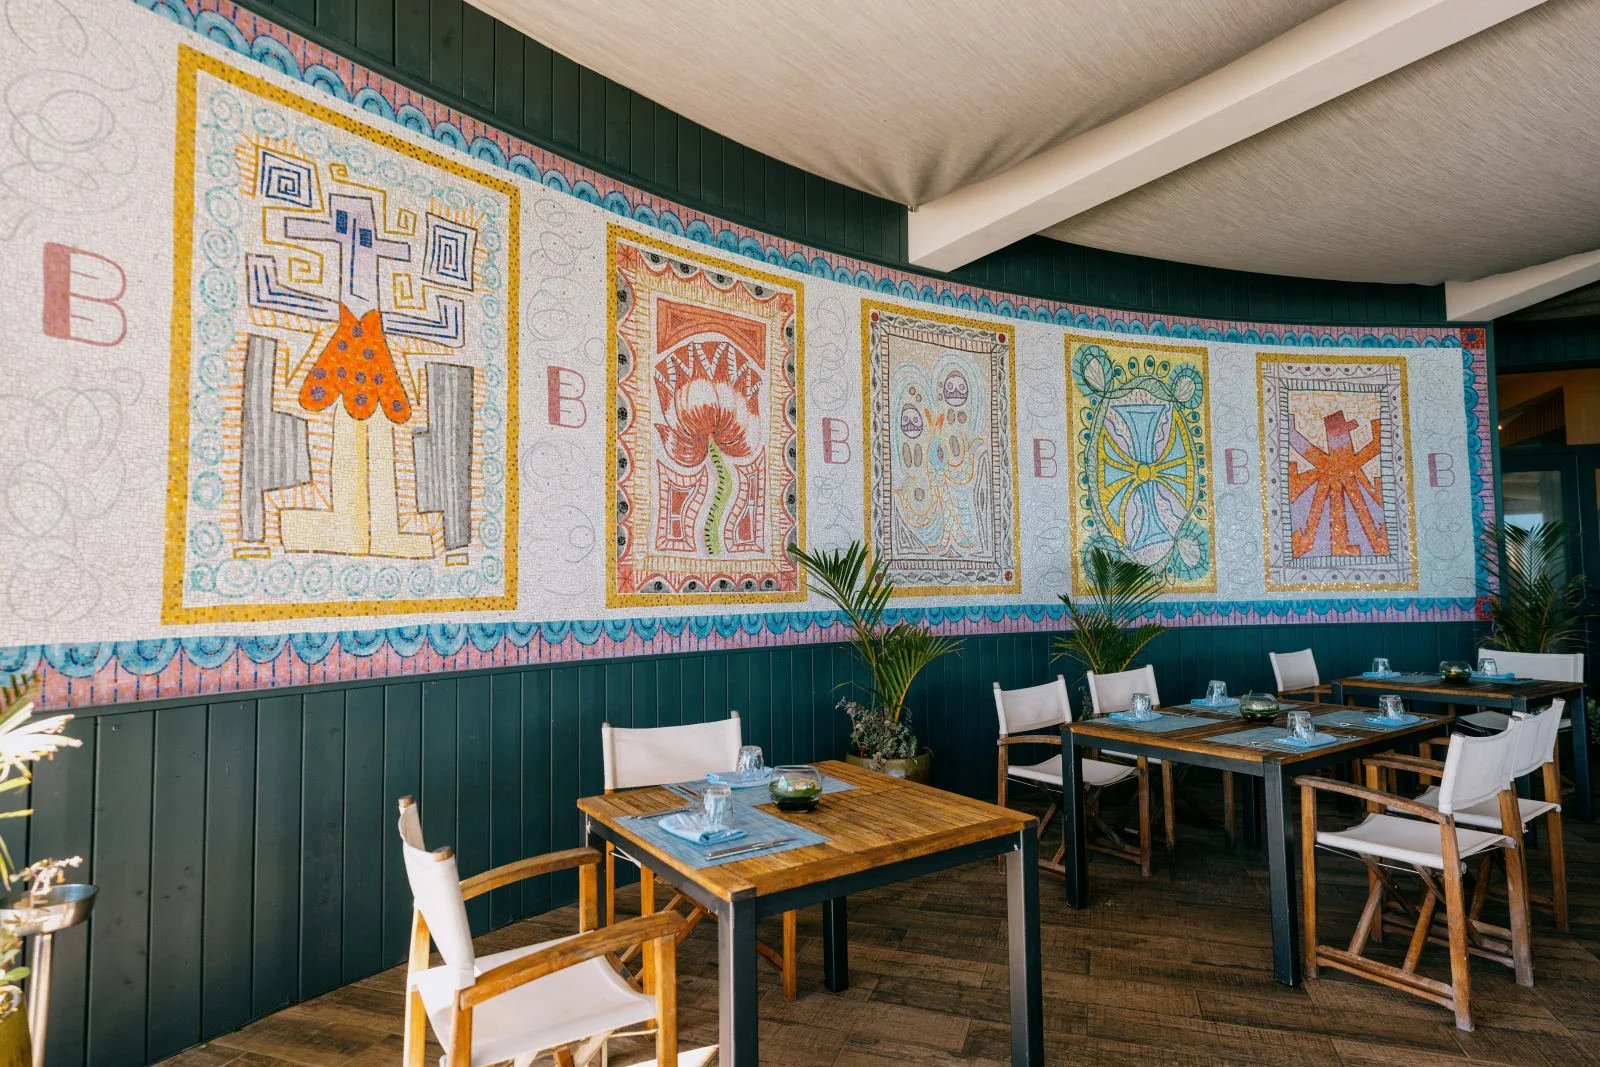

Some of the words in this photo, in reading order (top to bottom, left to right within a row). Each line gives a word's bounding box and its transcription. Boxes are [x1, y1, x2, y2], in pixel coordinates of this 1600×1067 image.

[43, 242, 126, 346] B
[547, 366, 586, 428] B
[822, 417, 850, 464] B
[1033, 439, 1057, 478] B
[1225, 448, 1249, 485] B
[1428, 452, 1455, 487] B
